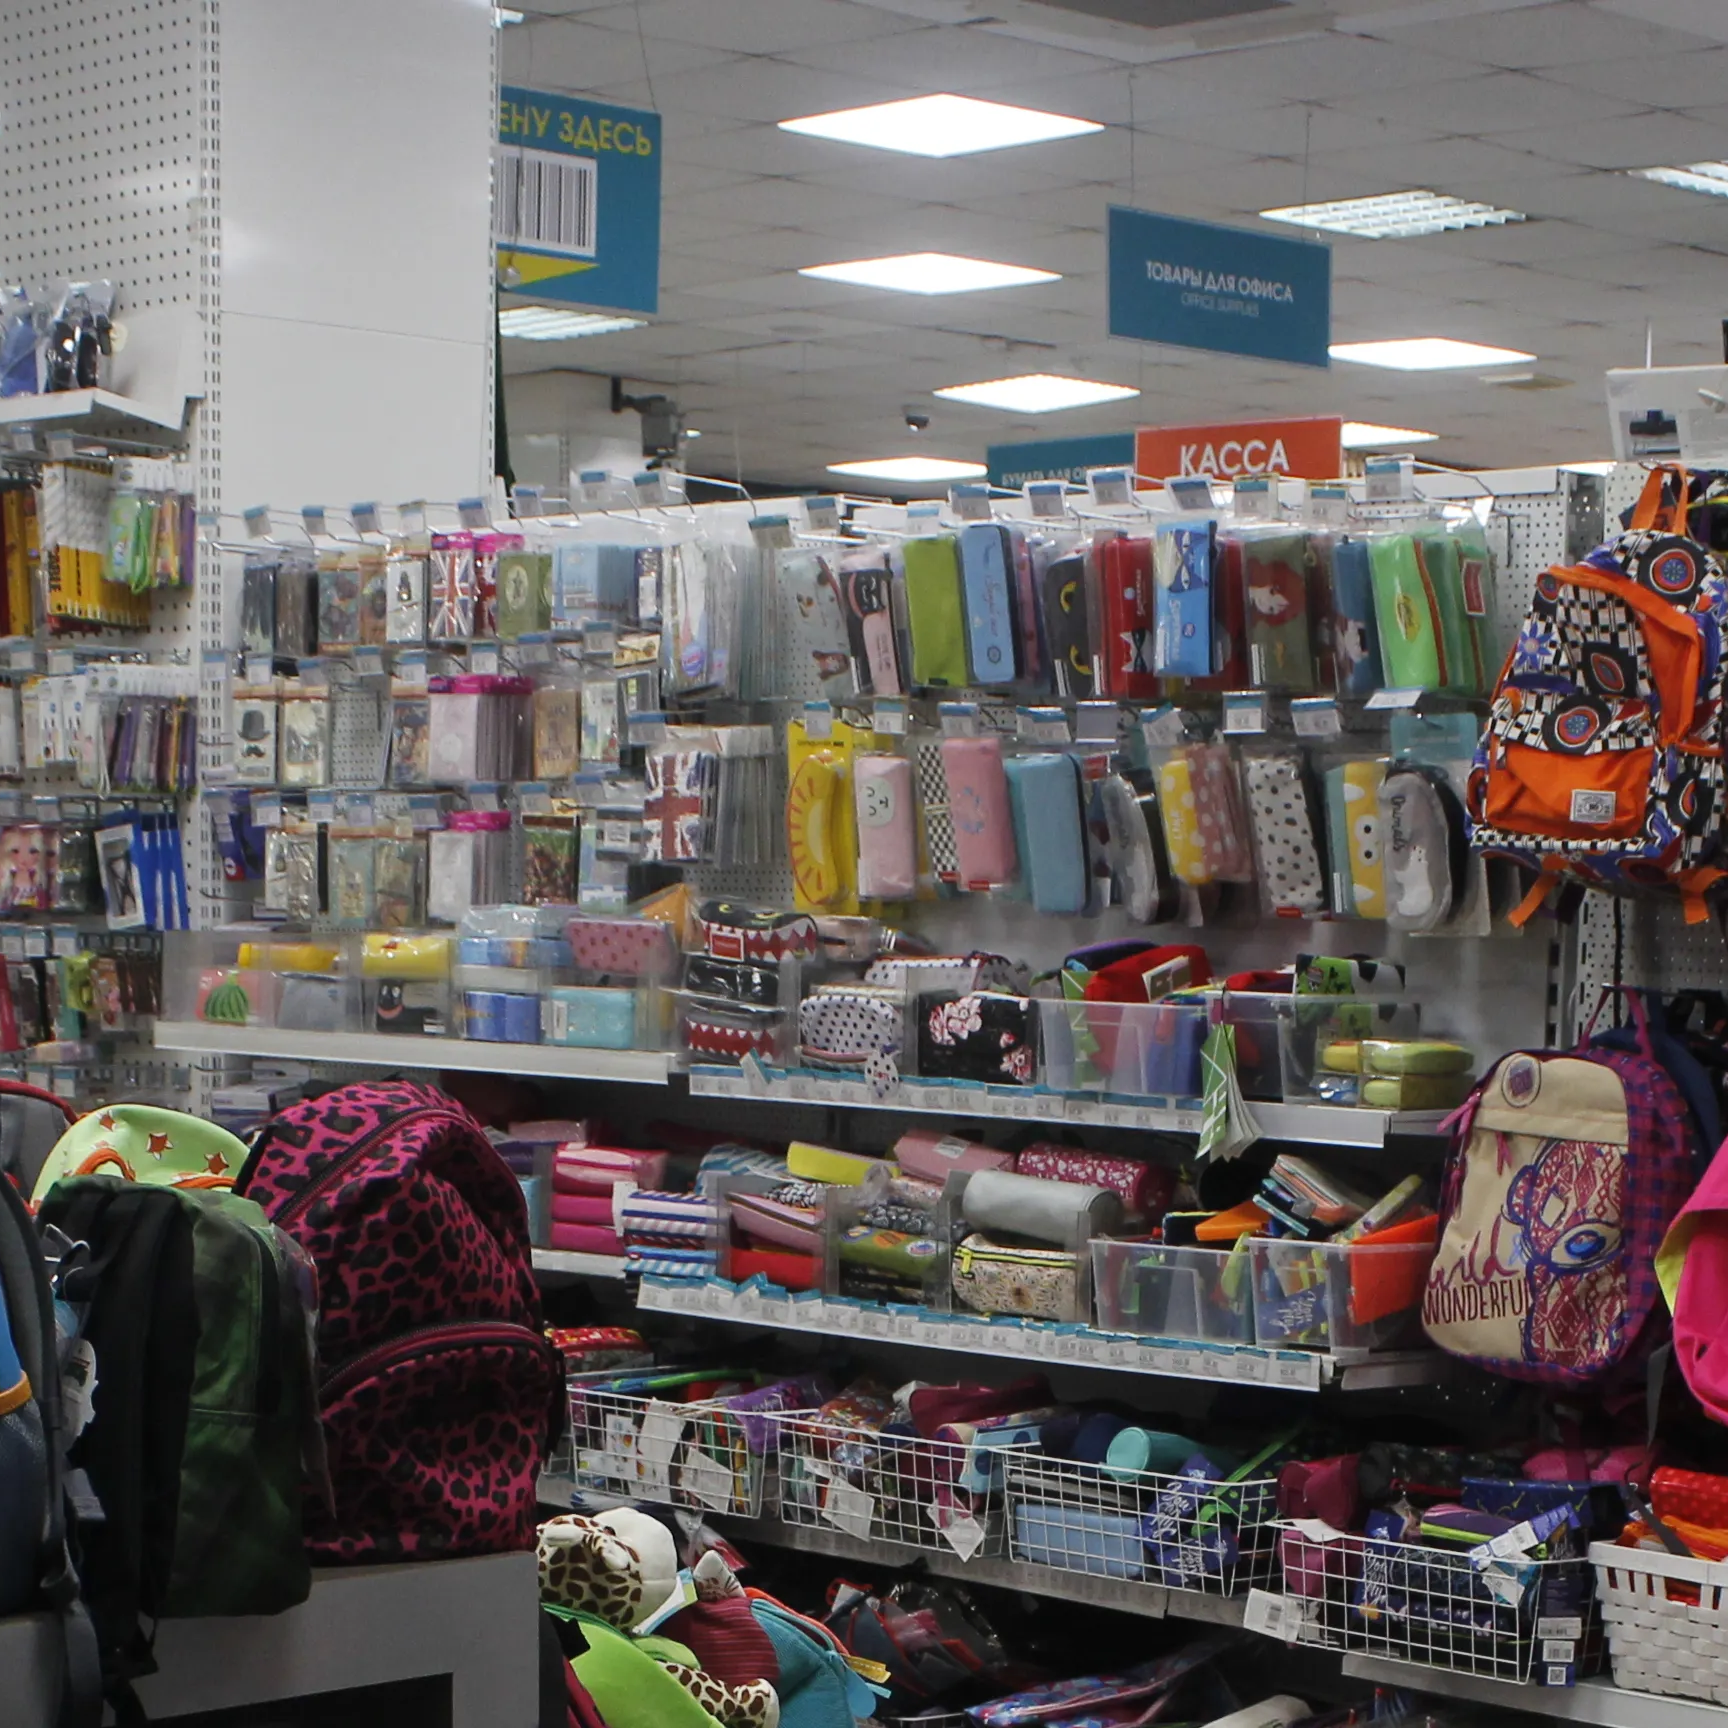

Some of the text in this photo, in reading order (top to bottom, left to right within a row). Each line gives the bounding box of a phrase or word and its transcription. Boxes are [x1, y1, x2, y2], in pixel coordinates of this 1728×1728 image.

[558, 112, 652, 156] ЗДЕСЬ
[1146, 260, 1294, 303] ТОВАРЫ ДЛЯ ОФИСА
[1180, 438, 1290, 477] КАССА
